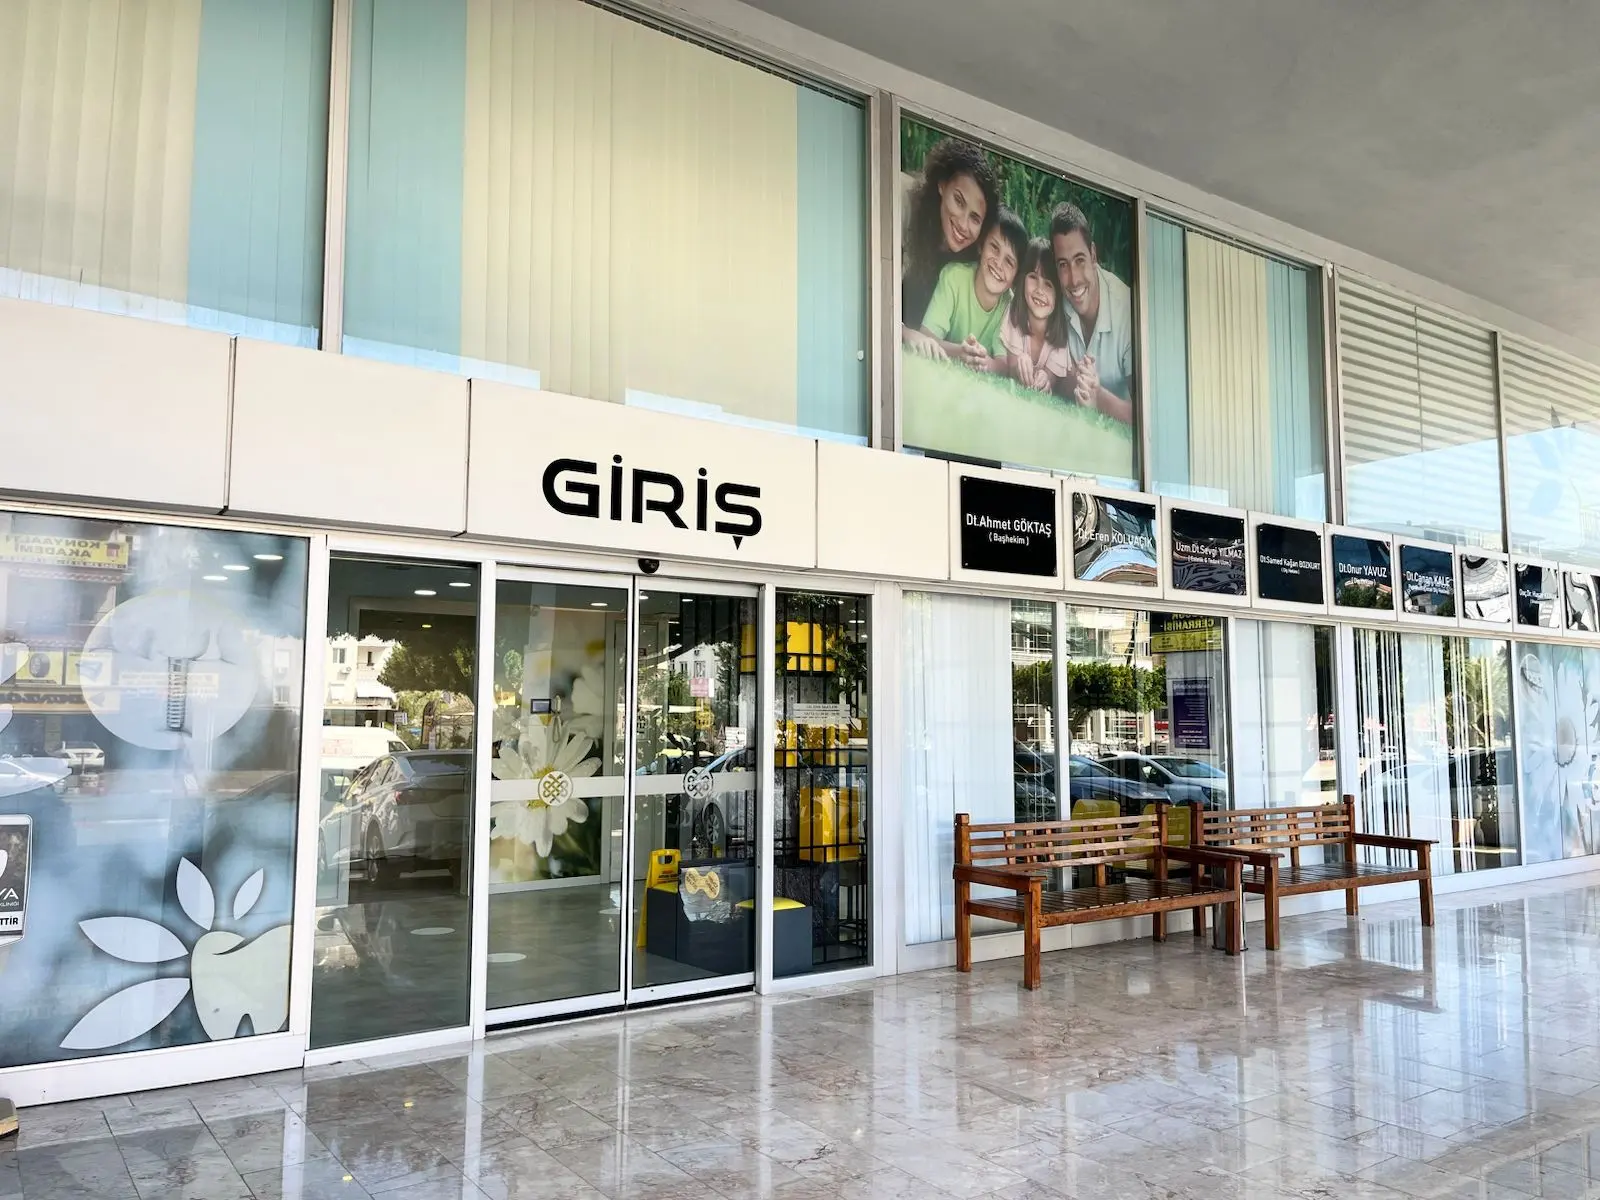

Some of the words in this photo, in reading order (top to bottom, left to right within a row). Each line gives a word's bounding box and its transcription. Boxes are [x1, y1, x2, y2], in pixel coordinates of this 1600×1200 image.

[542, 454, 762, 550] GİRİŞ
[966, 513, 1011, 531] Dt.Ahmet
[1013, 518, 1052, 538] GÖKTAŞ
[1338, 562, 1362, 575] Dt.Onur
[1363, 565, 1388, 578] YAVUZ
